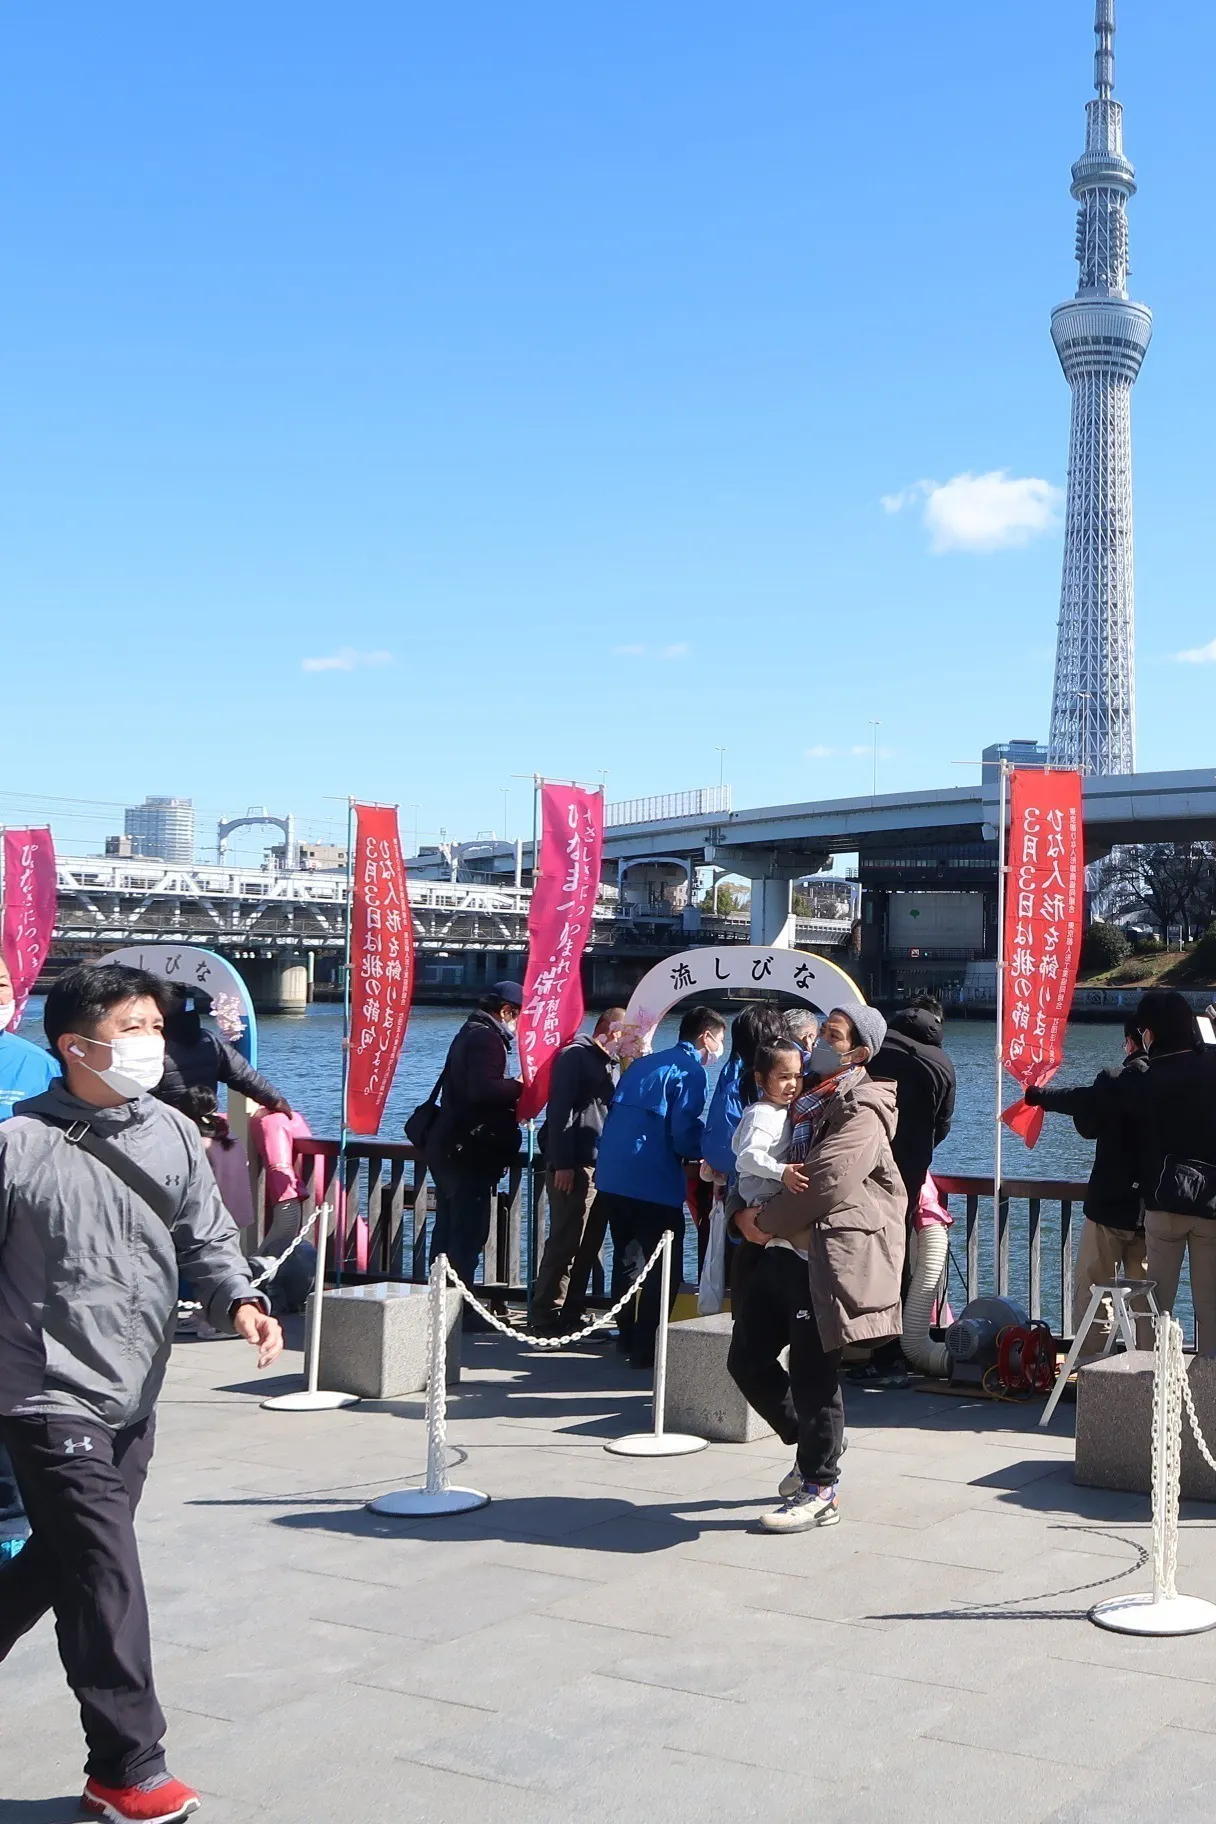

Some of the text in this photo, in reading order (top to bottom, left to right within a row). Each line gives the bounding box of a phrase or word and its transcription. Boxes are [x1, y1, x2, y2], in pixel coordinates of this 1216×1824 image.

[113, 953, 211, 982] しびな
[669, 956, 816, 991] 流しびな
